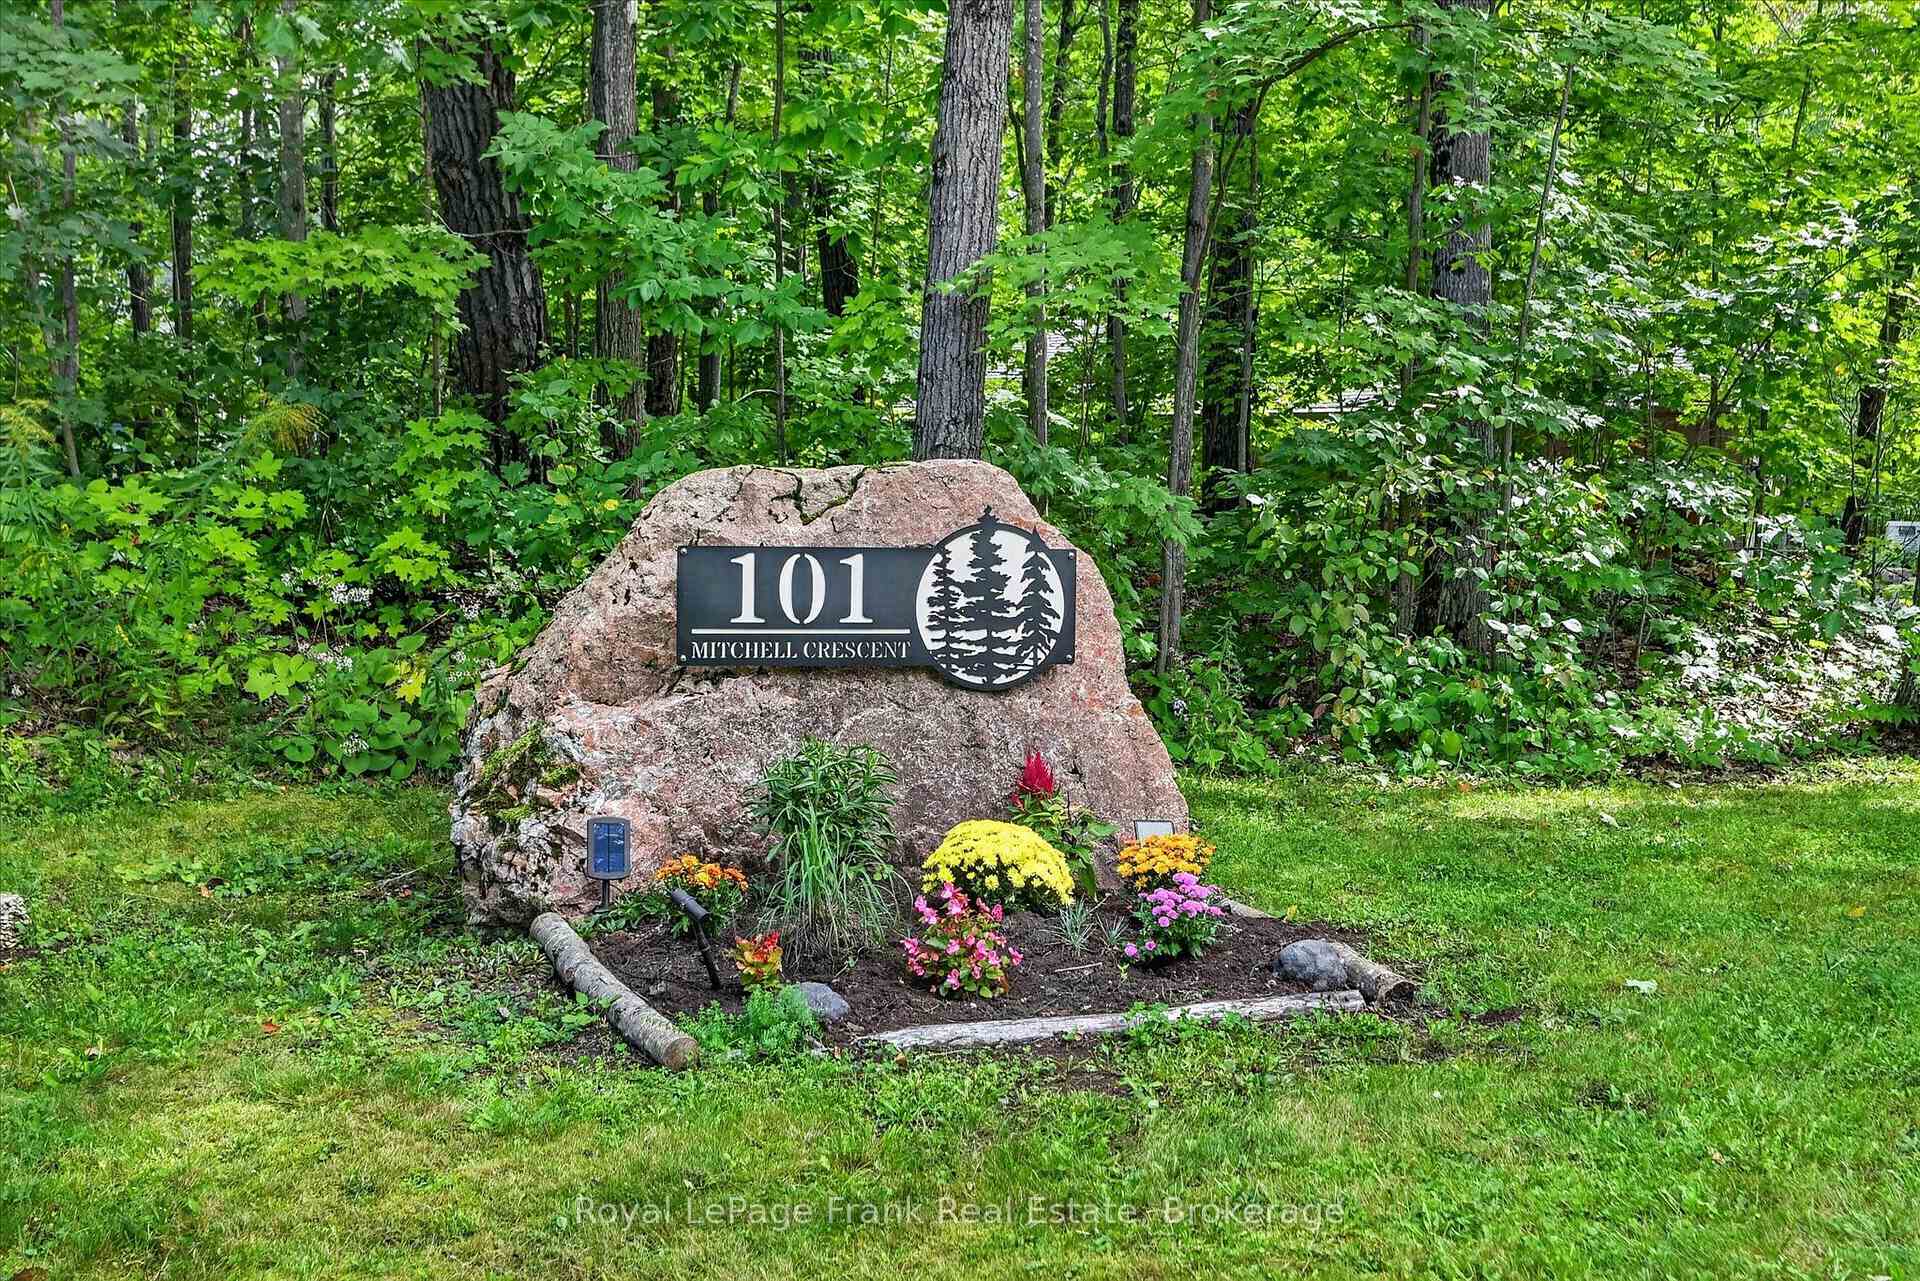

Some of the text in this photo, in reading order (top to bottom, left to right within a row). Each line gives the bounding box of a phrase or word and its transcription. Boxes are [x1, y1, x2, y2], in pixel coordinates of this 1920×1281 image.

[730, 552, 873, 624] 101
[691, 640, 911, 659] MITCHELL CRESCENT
